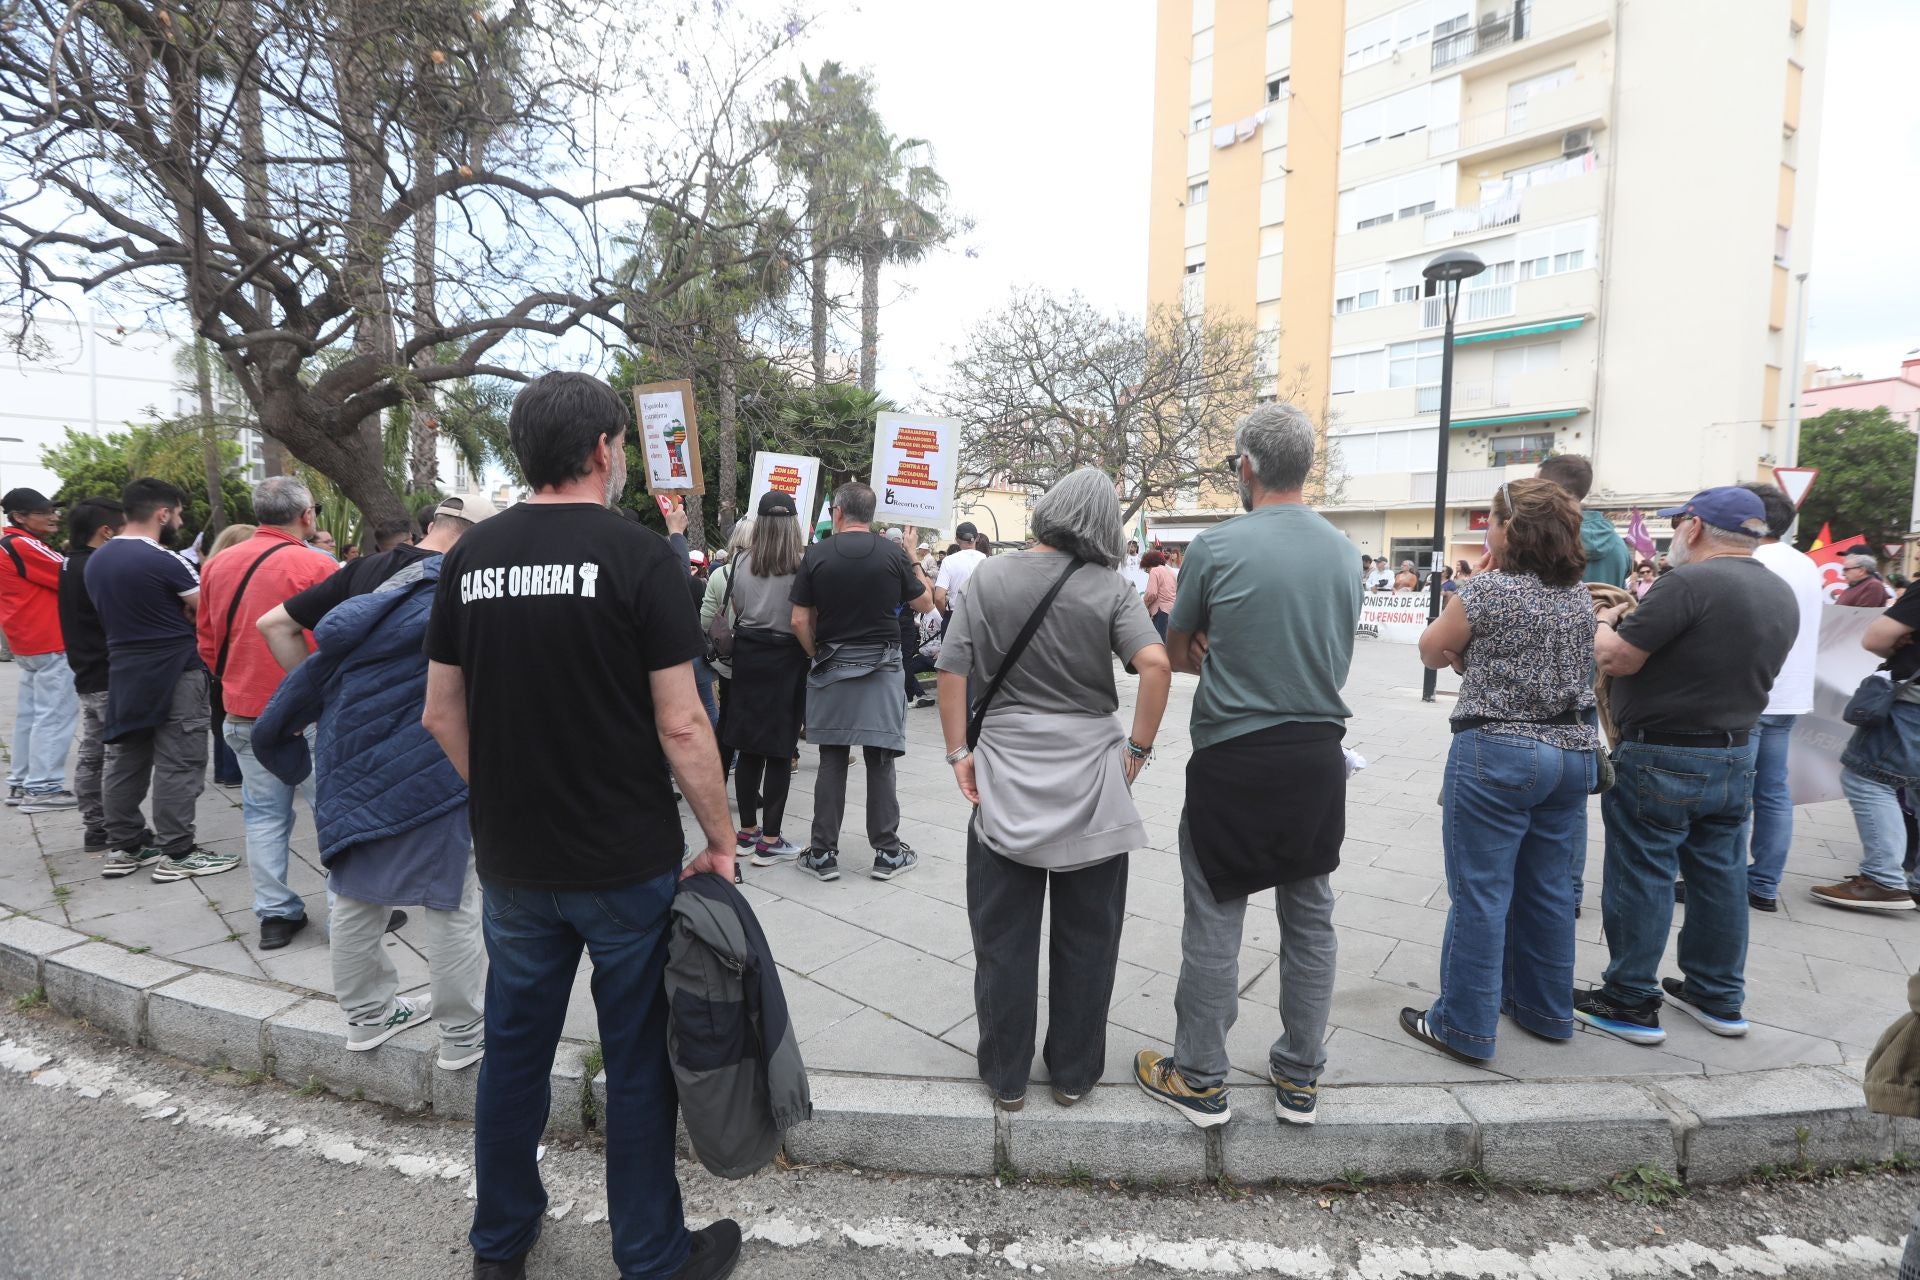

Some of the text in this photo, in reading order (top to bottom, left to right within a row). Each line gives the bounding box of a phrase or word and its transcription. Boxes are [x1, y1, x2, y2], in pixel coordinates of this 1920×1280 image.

[898, 470, 927, 478] DICTADURA
[893, 500, 918, 508] Recortes
[460, 564, 575, 605] CLASE OBRERA
[1363, 596, 1399, 608] ONISTAS
[1400, 597, 1412, 608] DE
[1364, 611, 1375, 622] TU
[1357, 623, 1379, 633] AREA
